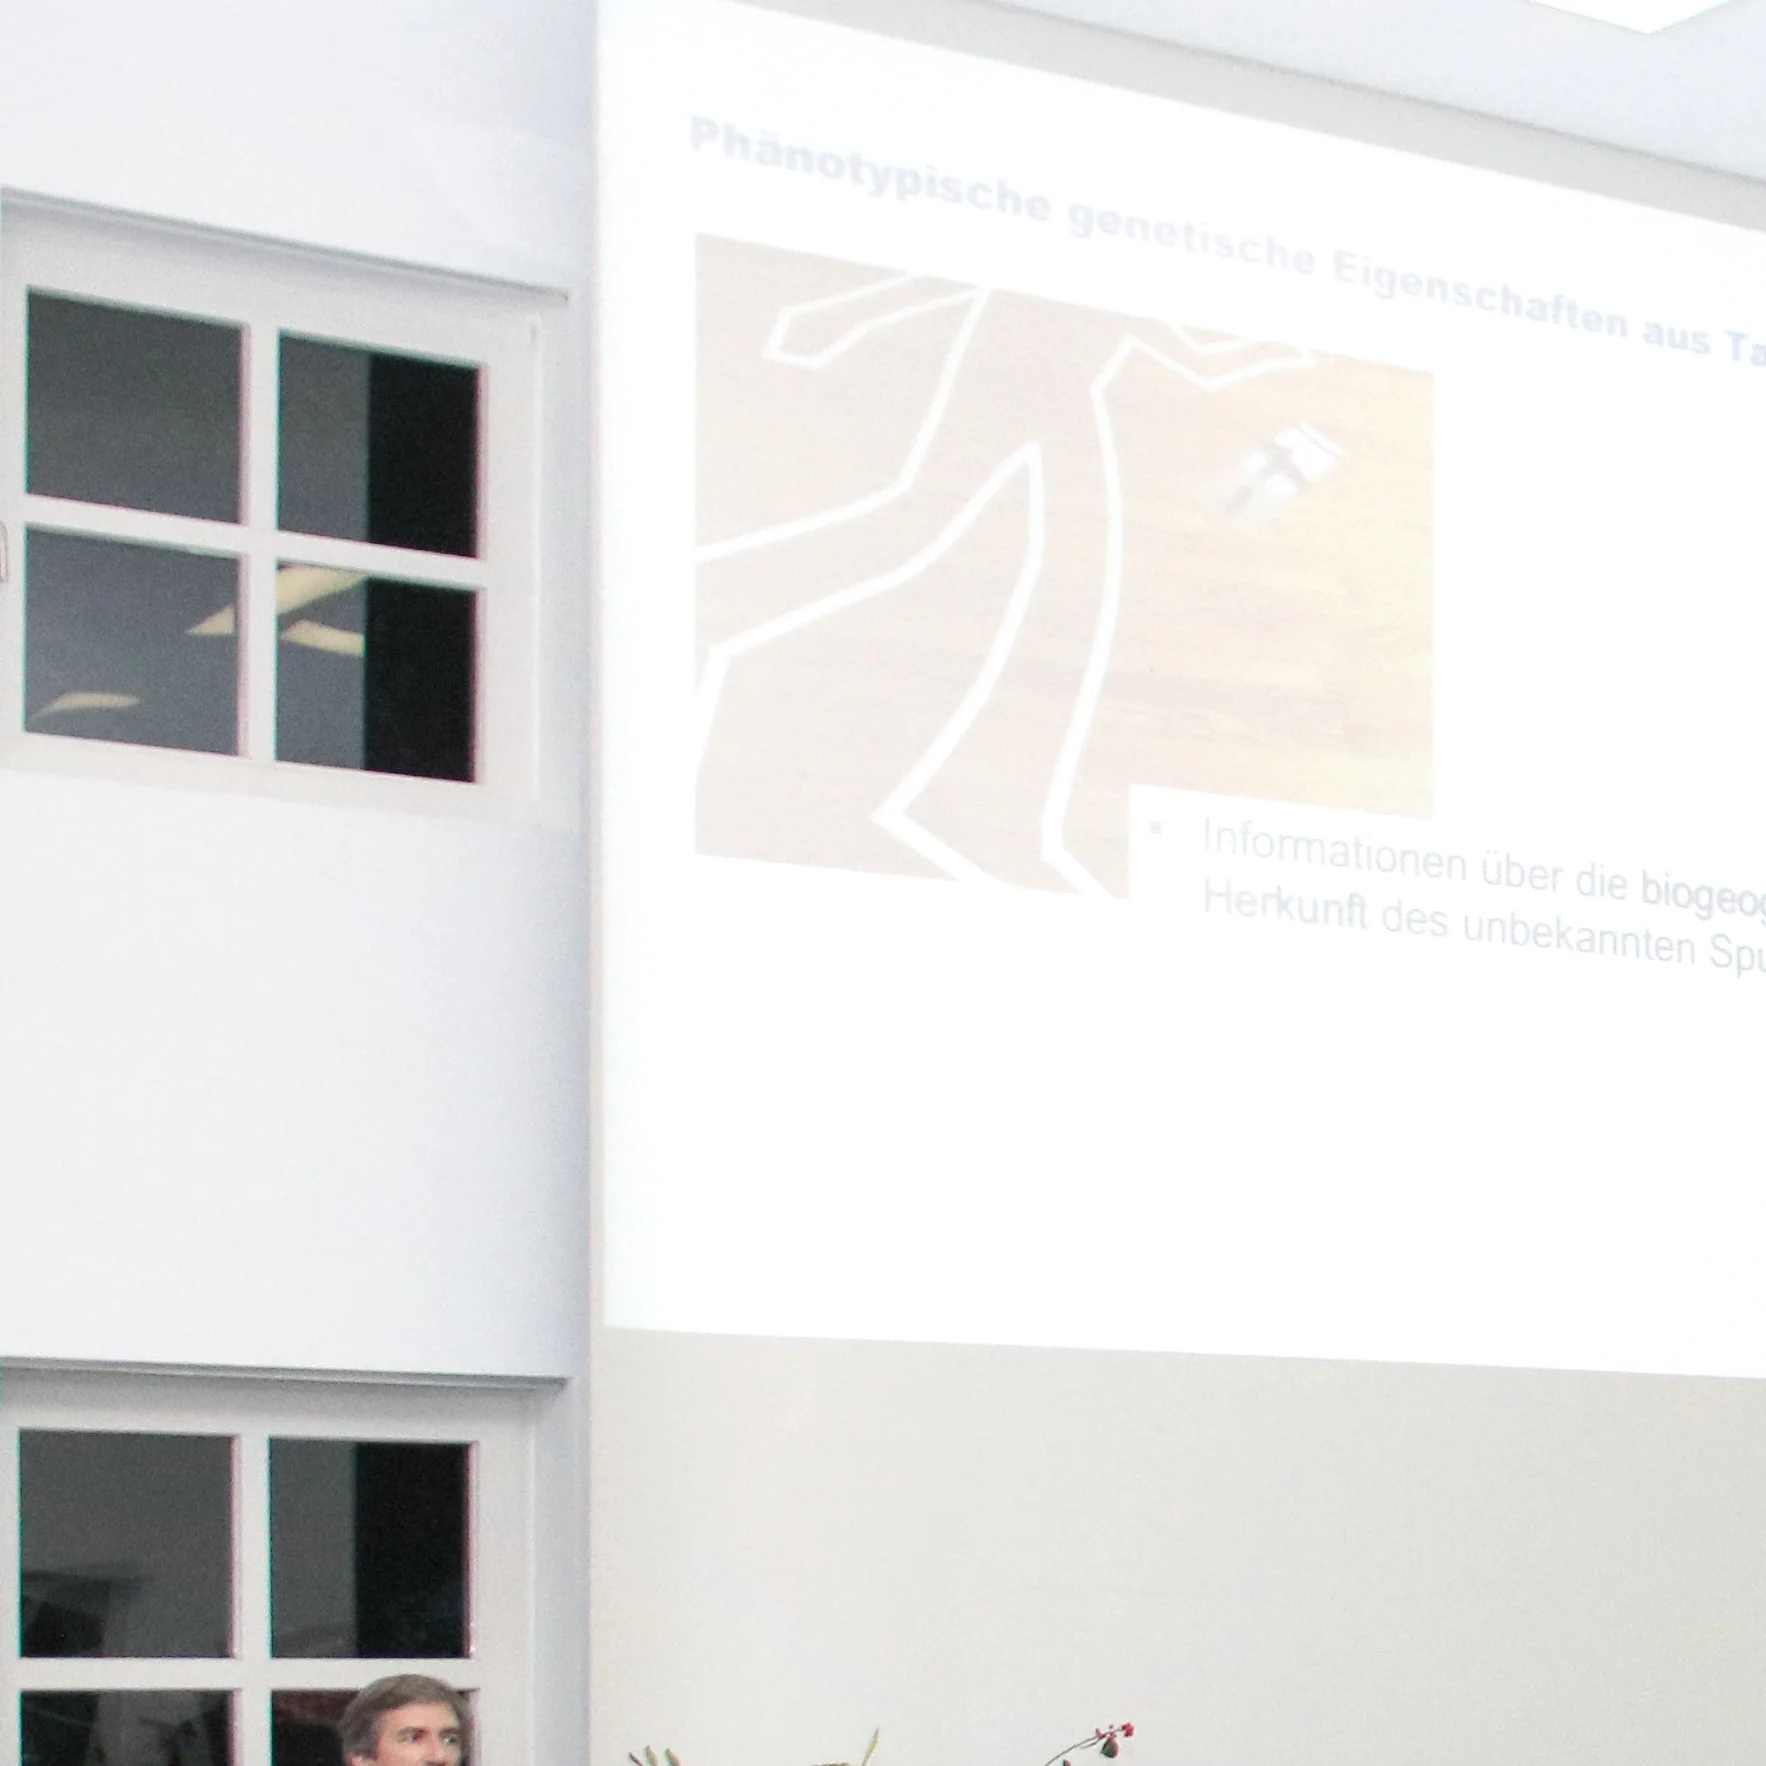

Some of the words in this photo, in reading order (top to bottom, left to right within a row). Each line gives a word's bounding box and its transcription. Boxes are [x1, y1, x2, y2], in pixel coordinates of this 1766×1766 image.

[690, 114, 1051, 222] Phänotypische
[1068, 201, 1315, 274] genetische
[1334, 247, 1628, 338] Eigenschaften
[1642, 316, 1711, 355] aus
[1203, 817, 1467, 881] Informationen
[1483, 847, 1563, 894] über
[1577, 862, 1627, 901] die
[1203, 876, 1369, 929] Herkunft
[1382, 894, 1448, 939] des
[1464, 910, 1696, 965] unbekannten
